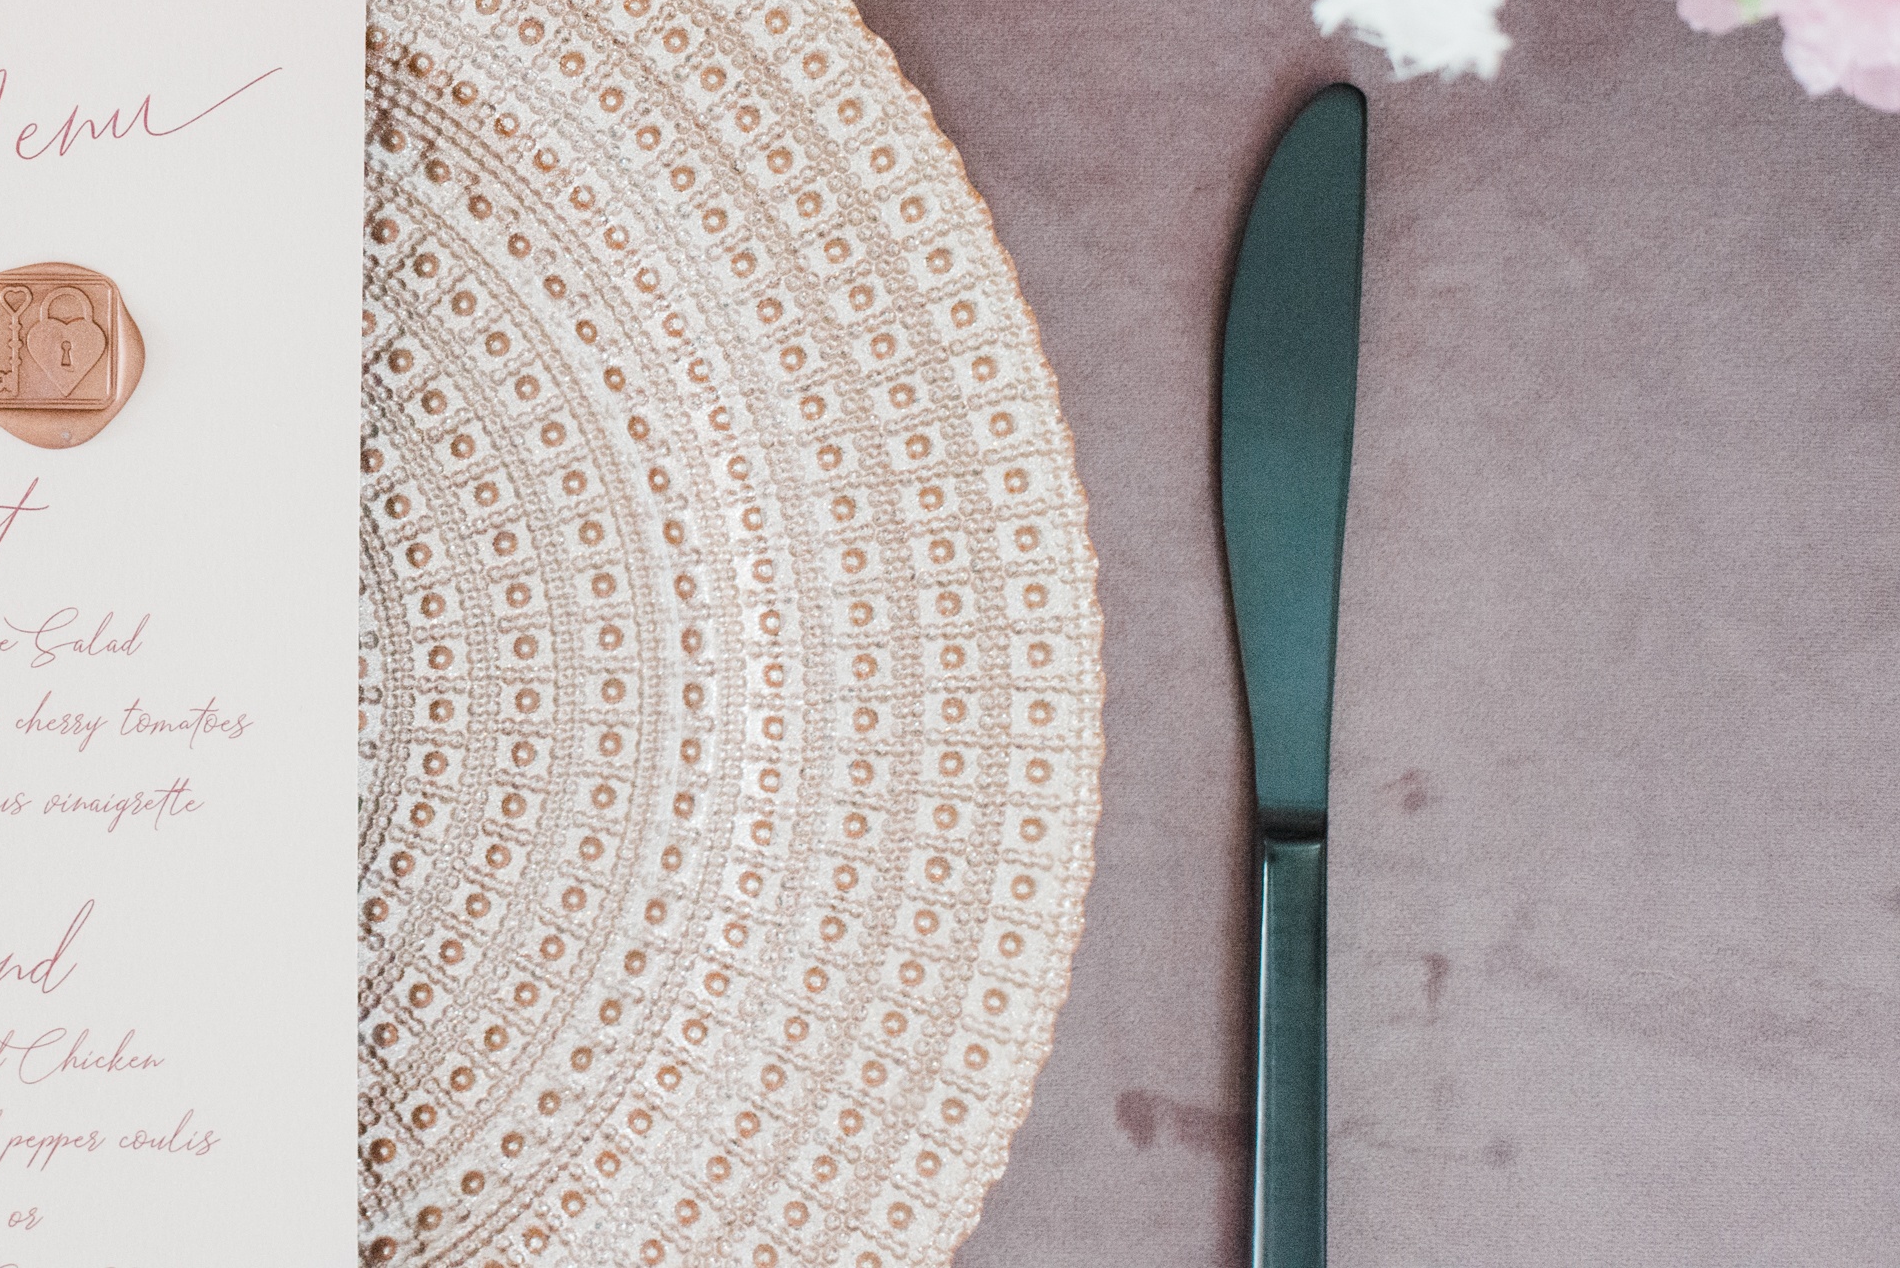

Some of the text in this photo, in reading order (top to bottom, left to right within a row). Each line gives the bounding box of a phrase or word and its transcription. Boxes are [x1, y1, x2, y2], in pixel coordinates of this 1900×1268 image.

[3, 606, 151, 669] Salad
[14, 690, 108, 753] cherry
[120, 696, 254, 754] tomatoes
[42, 777, 205, 834] vinaigrette
[118, 1108, 221, 1158] coulis
[7, 1206, 44, 1231] or
